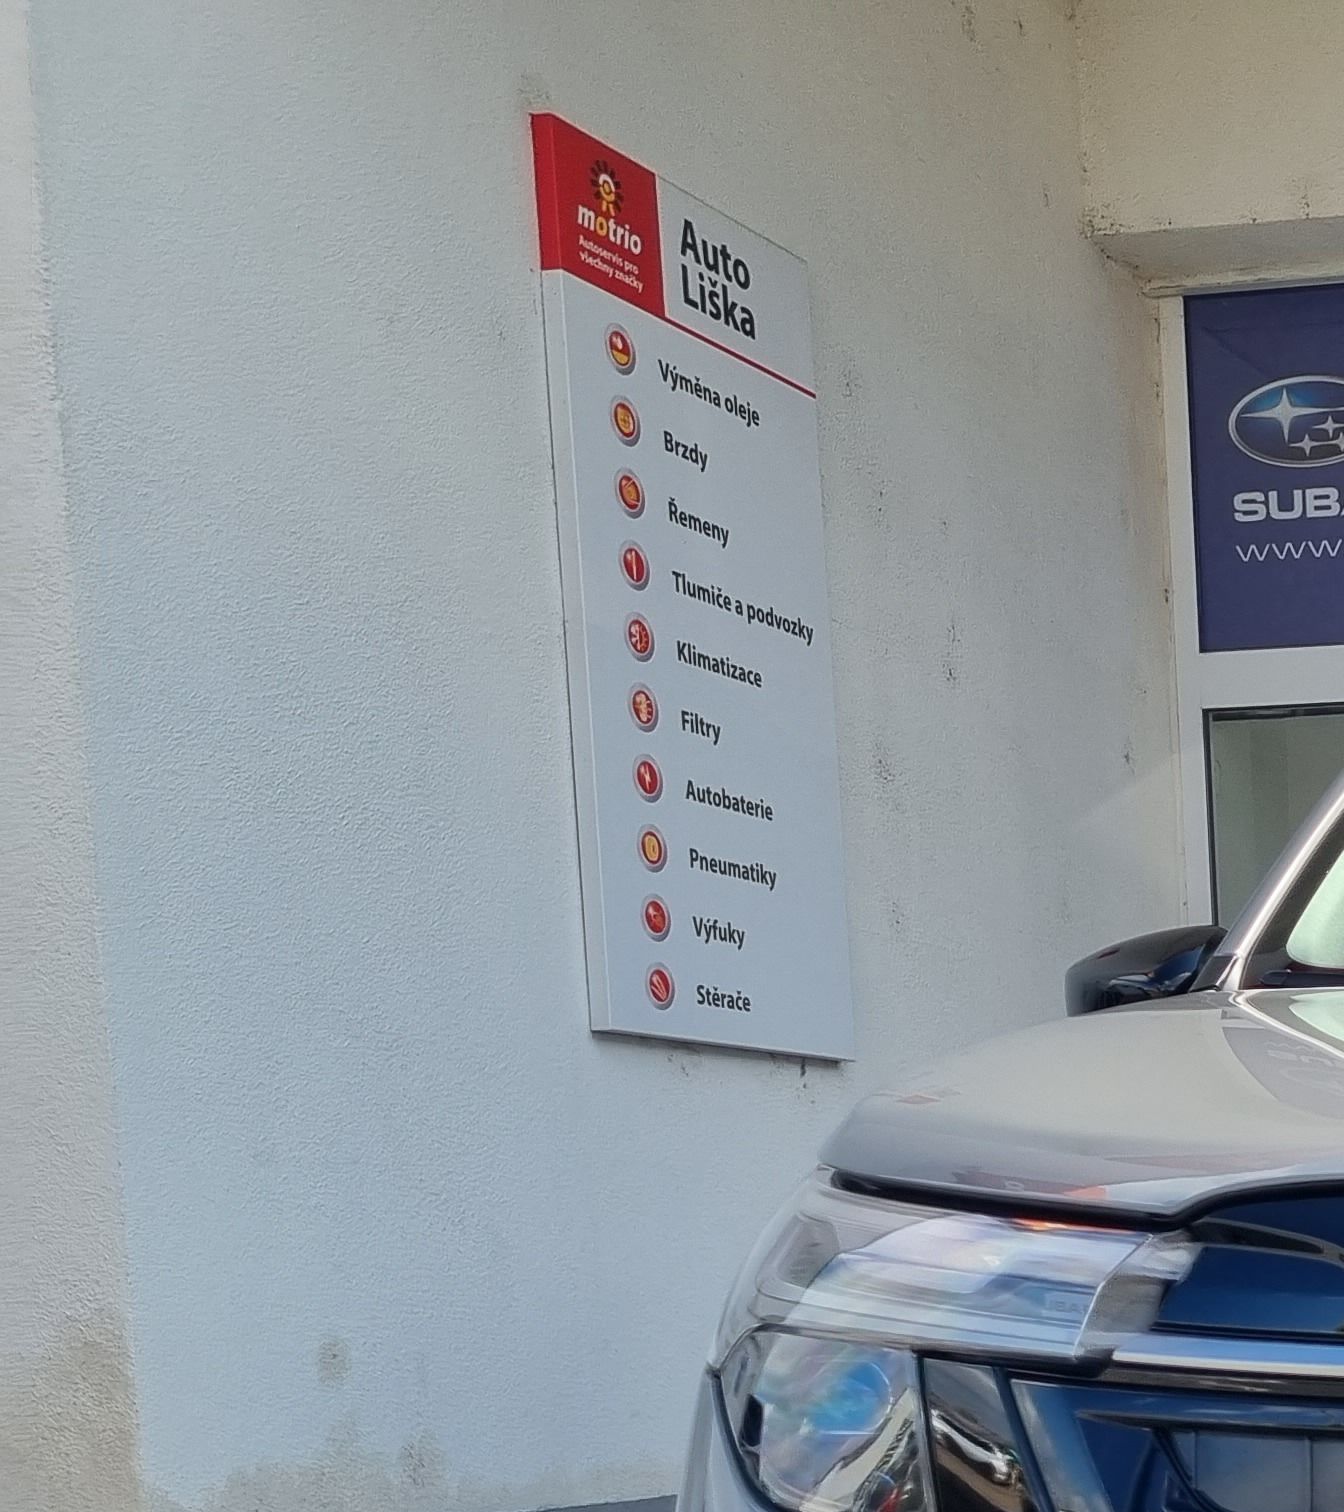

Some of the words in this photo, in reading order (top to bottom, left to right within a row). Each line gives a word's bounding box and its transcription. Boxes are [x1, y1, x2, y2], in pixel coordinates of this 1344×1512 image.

[577, 204, 642, 255] motrio
[578, 235, 623, 264] Autoservis
[623, 260, 639, 276] pro
[680, 218, 751, 290] Auto
[614, 270, 644, 294] značky
[681, 263, 756, 340] Liška
[658, 358, 722, 408] Výměna
[724, 393, 760, 428] oleje
[663, 430, 708, 472] Brzdy
[668, 496, 730, 549] Řemeny
[672, 570, 732, 613] Tlumiče
[734, 600, 744, 617] a
[746, 601, 814, 647] podvozky
[676, 640, 763, 688] Klimatizace
[681, 710, 721, 746] Filtry
[686, 779, 774, 821] Autobaterie
[689, 848, 777, 892] Pneumatiky
[692, 915, 745, 950] Výfuky
[696, 984, 751, 1013] Stěrače
